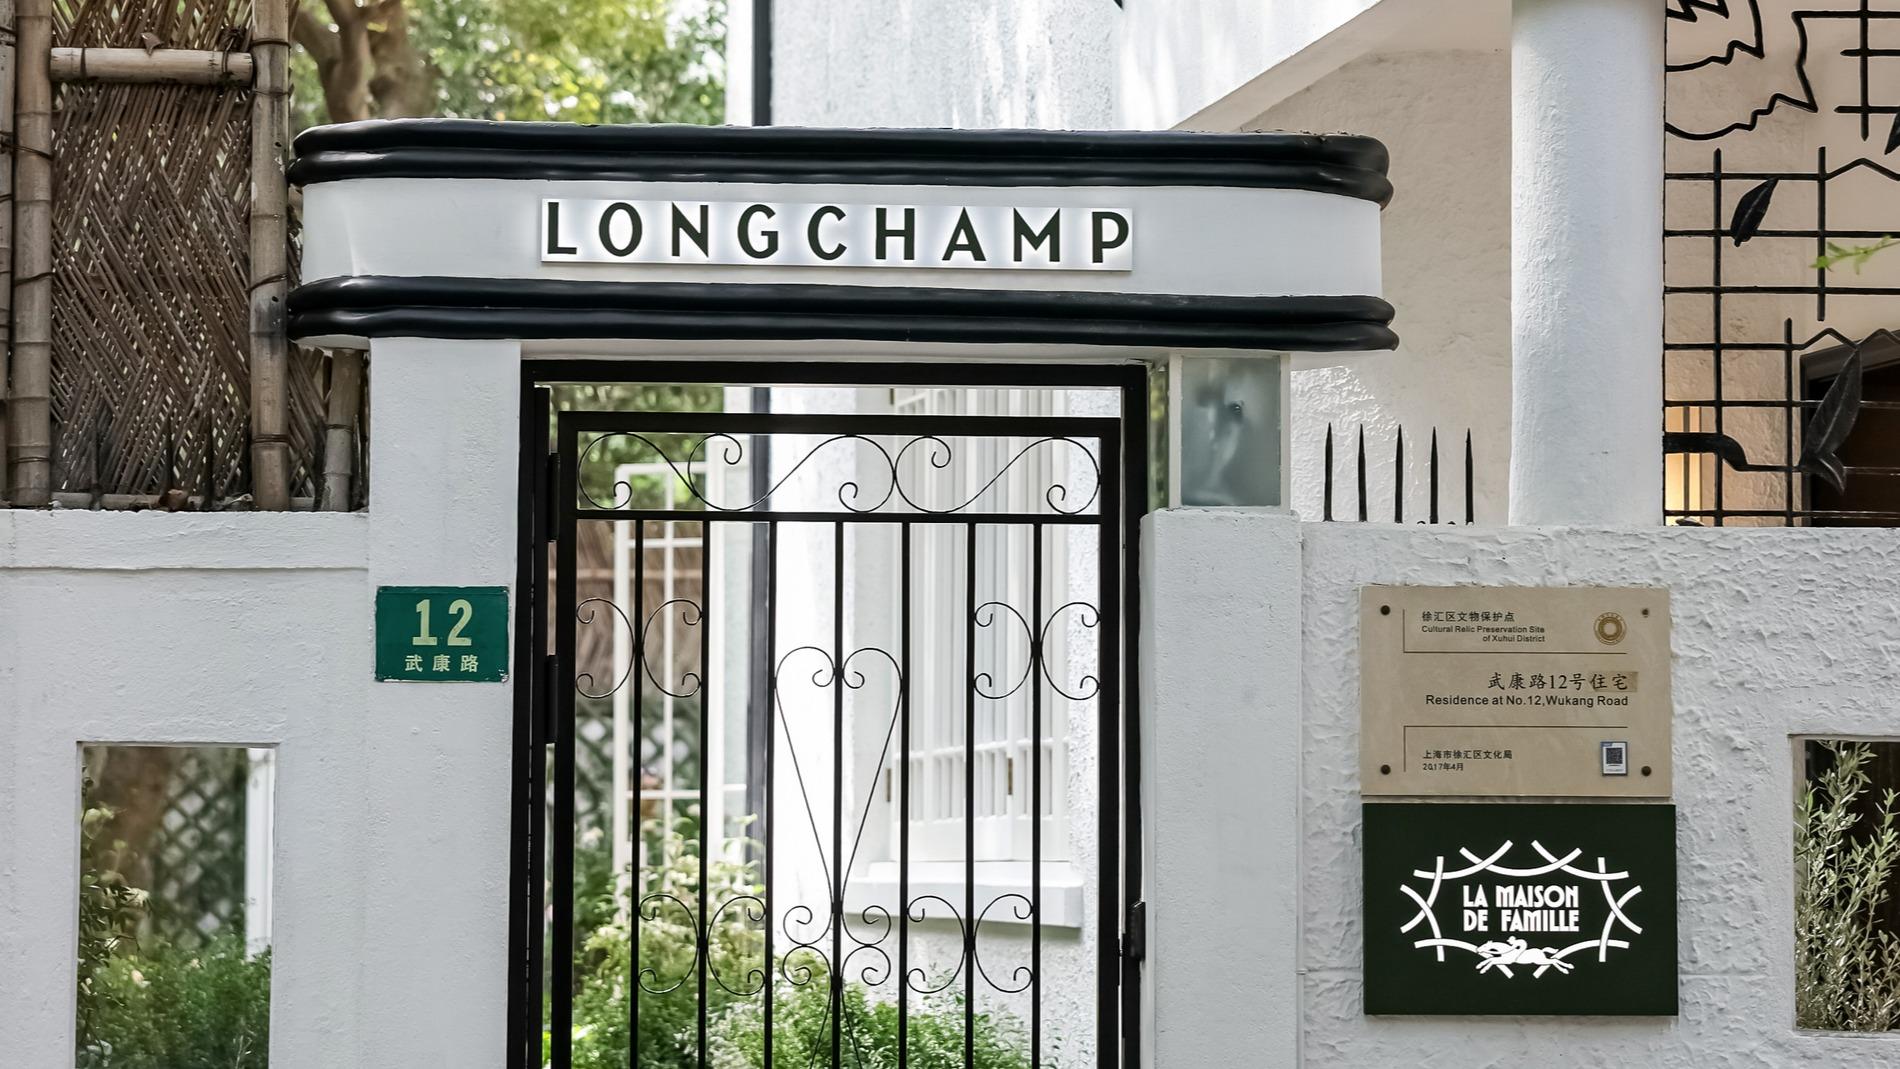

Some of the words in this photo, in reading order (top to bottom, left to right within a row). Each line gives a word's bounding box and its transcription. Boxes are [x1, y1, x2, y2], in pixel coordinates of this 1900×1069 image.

[547, 201, 1130, 264] LONGCHAMP
[412, 599, 473, 646] 12
[1421, 611, 1516, 623] 徐汇区文物保护点
[1421, 625, 1454, 634] Cultural
[1455, 625, 1476, 634] Relic
[1476, 625, 1527, 634] Preservation
[1529, 625, 1545, 634] Site
[1482, 634, 1491, 643] of
[1492, 634, 1515, 643] Xuhui
[1516, 634, 1545, 643] District
[404, 654, 479, 673] 武康路
[1488, 671, 1629, 691] 武康路12号住宅
[1425, 694, 1489, 706] Residence
[1491, 696, 1503, 706] at
[1597, 695, 1629, 707] Road
[1423, 750, 1513, 760] 上海市徐汇区文化局
[1463, 884, 1489, 908] LA
[1495, 885, 1579, 909] MAISON
[1463, 910, 1489, 932] DE
[1501, 909, 1580, 932] FAMILLE
